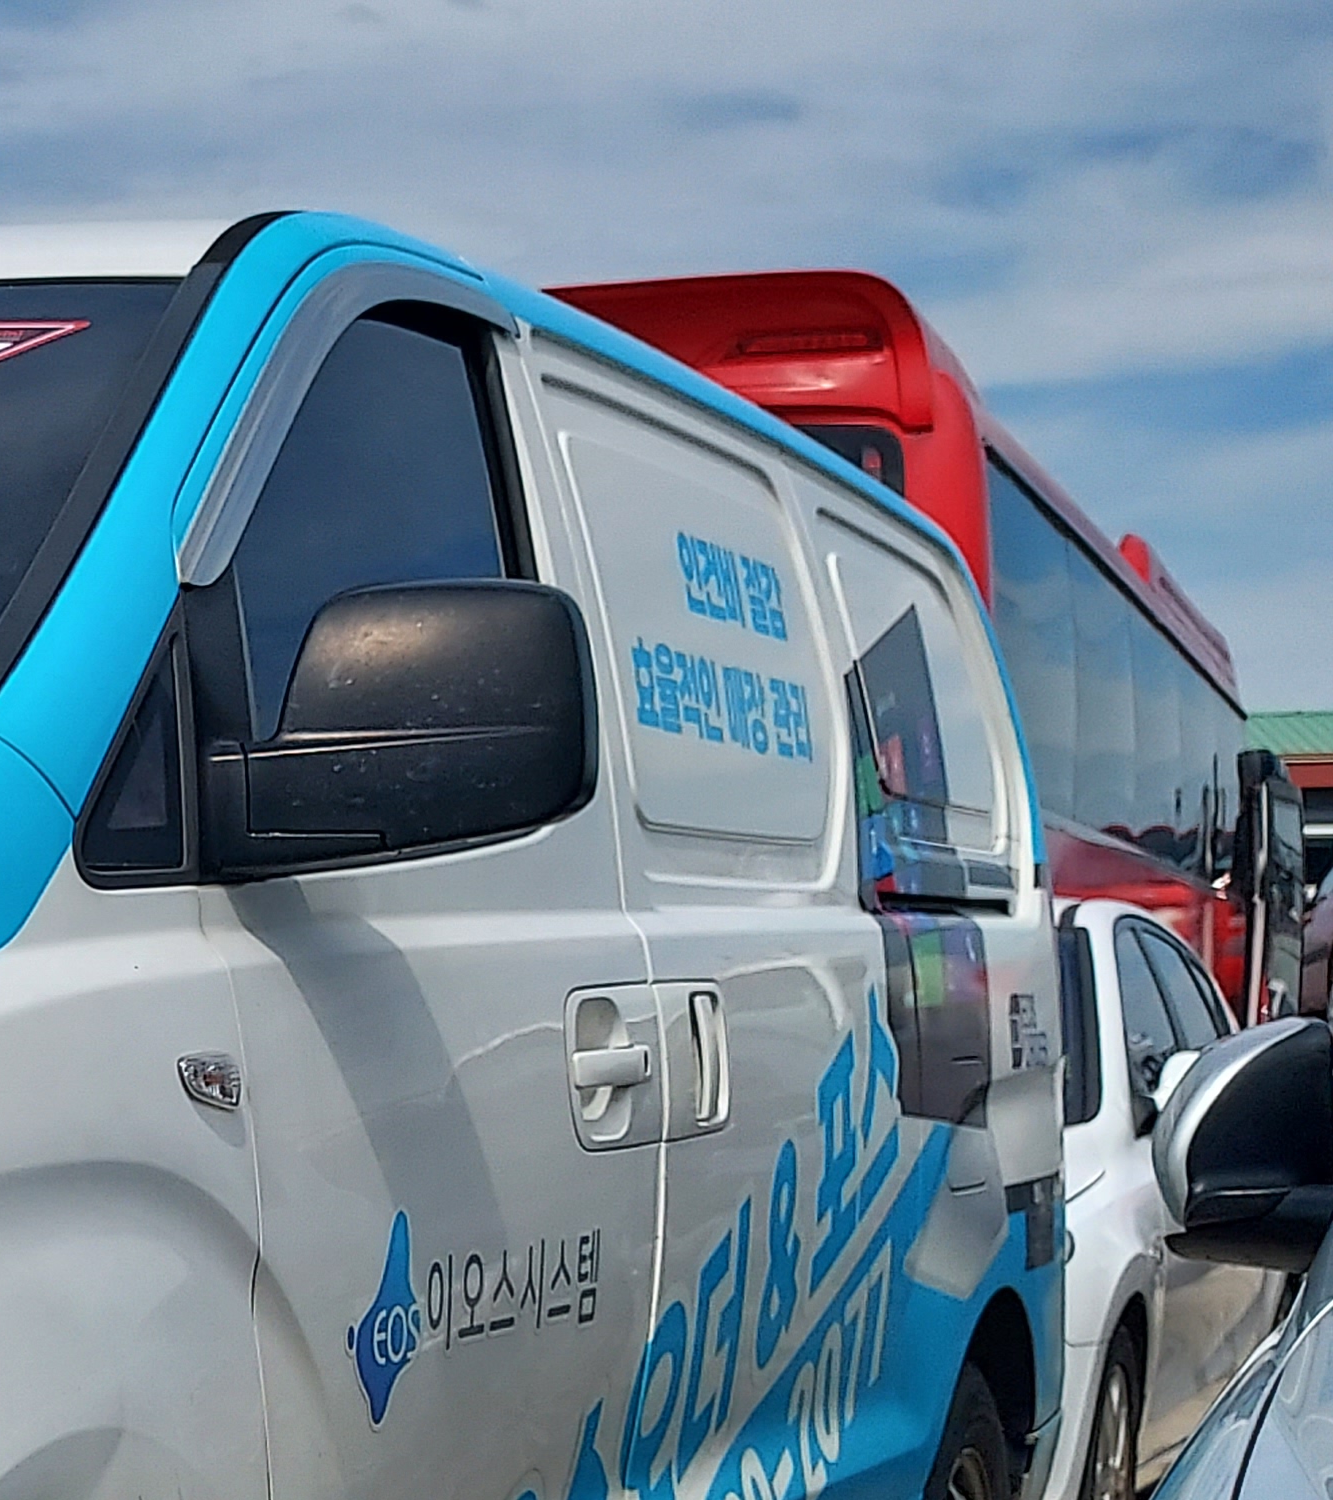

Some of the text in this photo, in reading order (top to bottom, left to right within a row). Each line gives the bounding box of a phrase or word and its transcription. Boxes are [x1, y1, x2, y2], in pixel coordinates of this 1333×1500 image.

[676, 530, 788, 642] 인건비 절감
[631, 635, 724, 744] 효율적인
[722, 665, 770, 755] 매장
[373, 1304, 421, 1366] EOS
[427, 1227, 601, 1351] 이오스시스템
